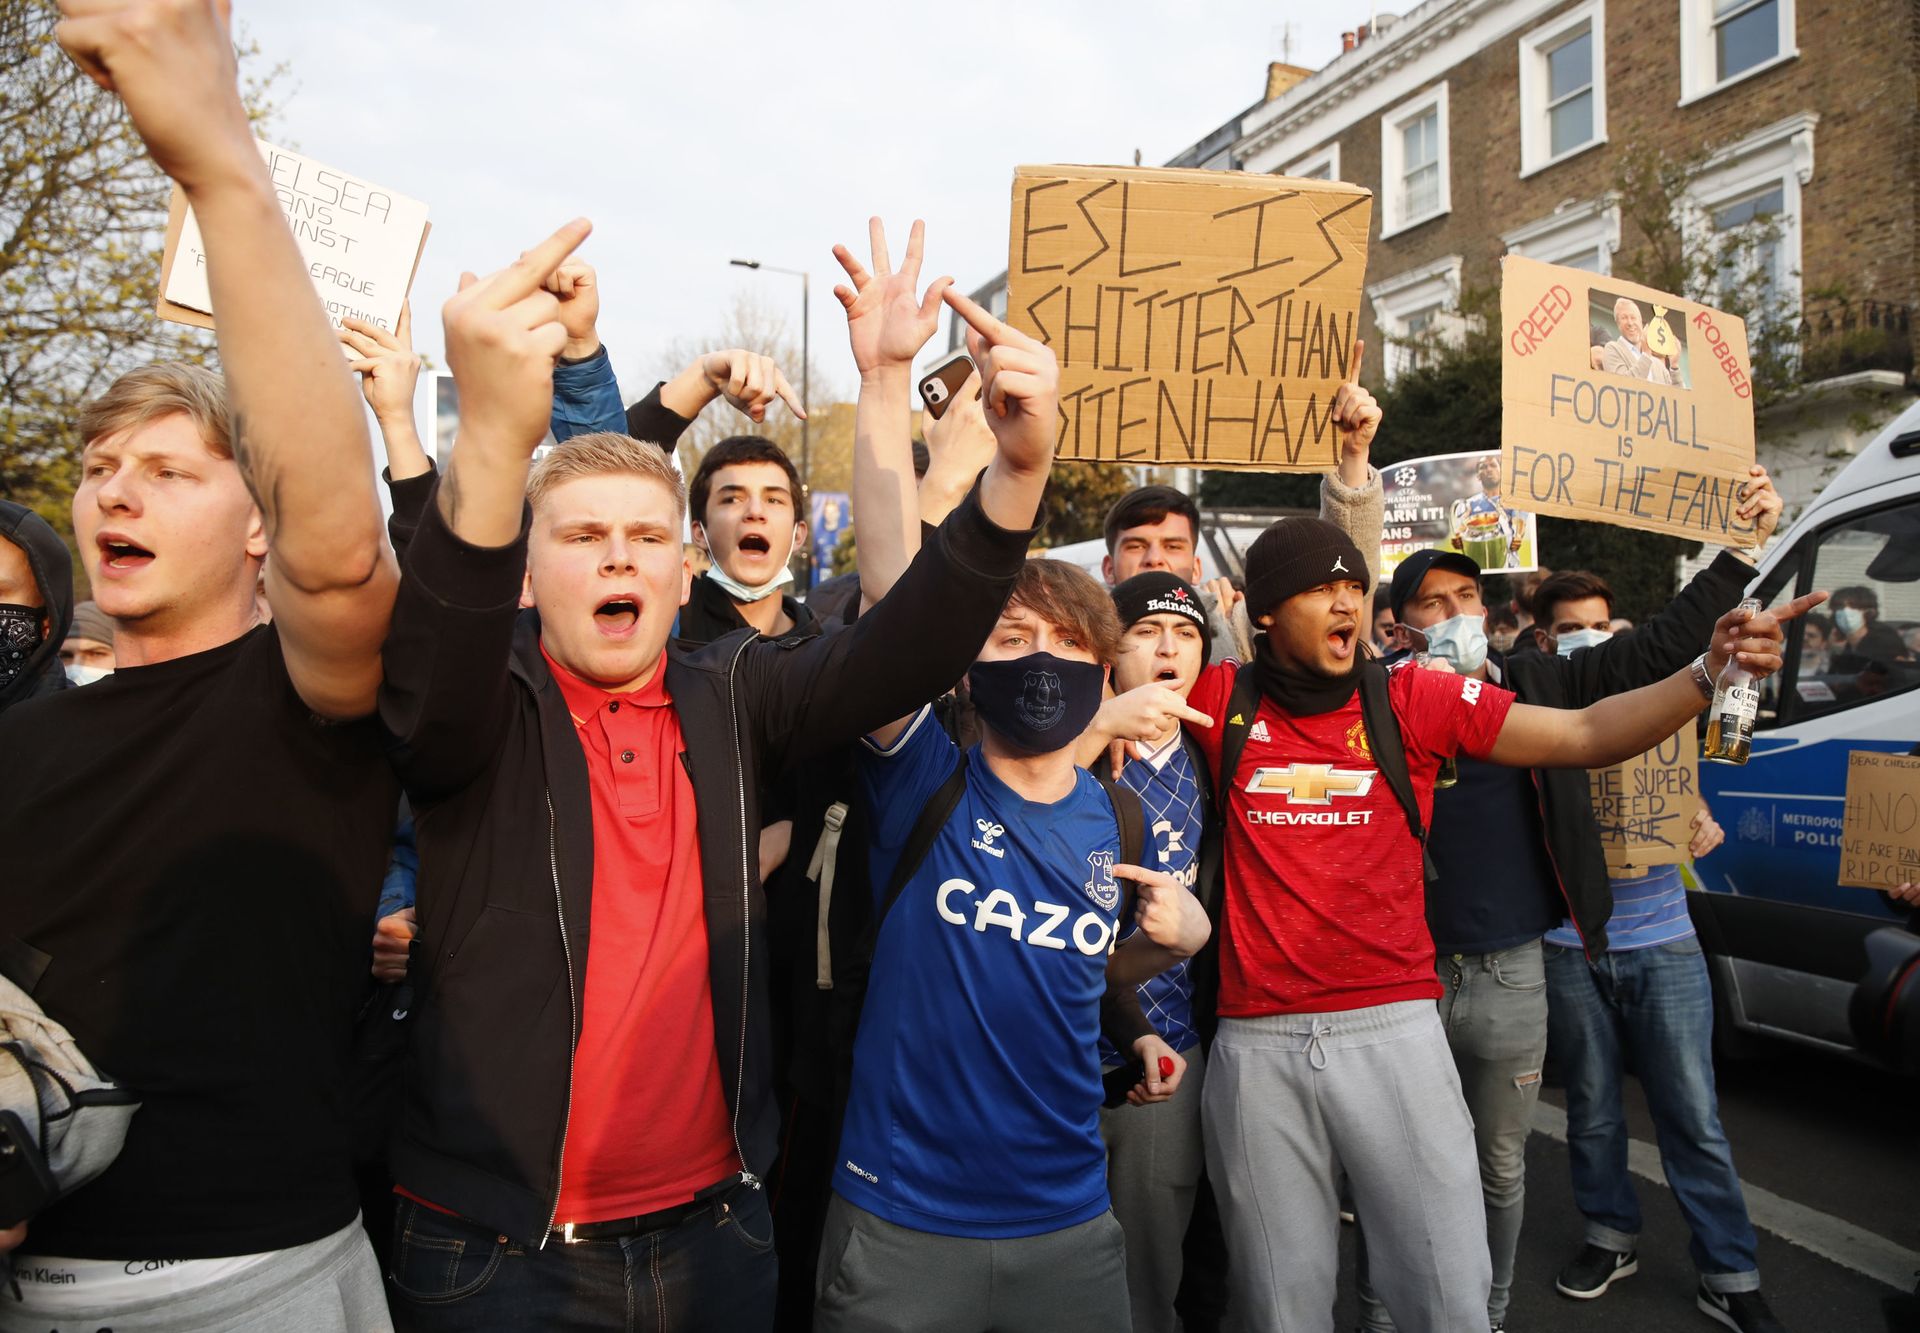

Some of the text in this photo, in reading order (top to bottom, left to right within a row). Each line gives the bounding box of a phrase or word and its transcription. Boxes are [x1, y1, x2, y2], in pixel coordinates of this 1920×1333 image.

[265, 151, 392, 224] ELSEA
[275, 189, 333, 226] ANS
[283, 212, 359, 254] INST
[1022, 179, 1373, 287] ESL IS
[309, 262, 376, 297] EAGUE
[1026, 284, 1353, 380] SHITTER THAN
[1510, 284, 1572, 357] GREED
[1692, 311, 1751, 399] ROBBED
[1056, 376, 1340, 465] TTENHAM
[1550, 373, 1709, 451] FOOTBALL
[1617, 435, 1633, 458] IS
[1510, 445, 1575, 506] FOR
[1594, 458, 1660, 518] THE
[1384, 494, 1433, 504] HAMPIONS
[1383, 506, 1444, 523] ARN IT!
[1381, 527, 1412, 540] ANS
[1147, 599, 1204, 624] Heineken
[1850, 755, 1879, 767] DEAR
[1589, 766, 1694, 796] HE SUPER
[1246, 810, 1373, 826] CHEVROLET
[1595, 818, 1662, 845] EAGUE
[1782, 813, 1843, 829] METROPOL
[971, 838, 1004, 858] hummel
[1795, 830, 1843, 847] POLIC
[1845, 839, 1864, 854] WE
[1868, 842, 1893, 858] ARE
[35, 1267, 76, 1284] Klein
